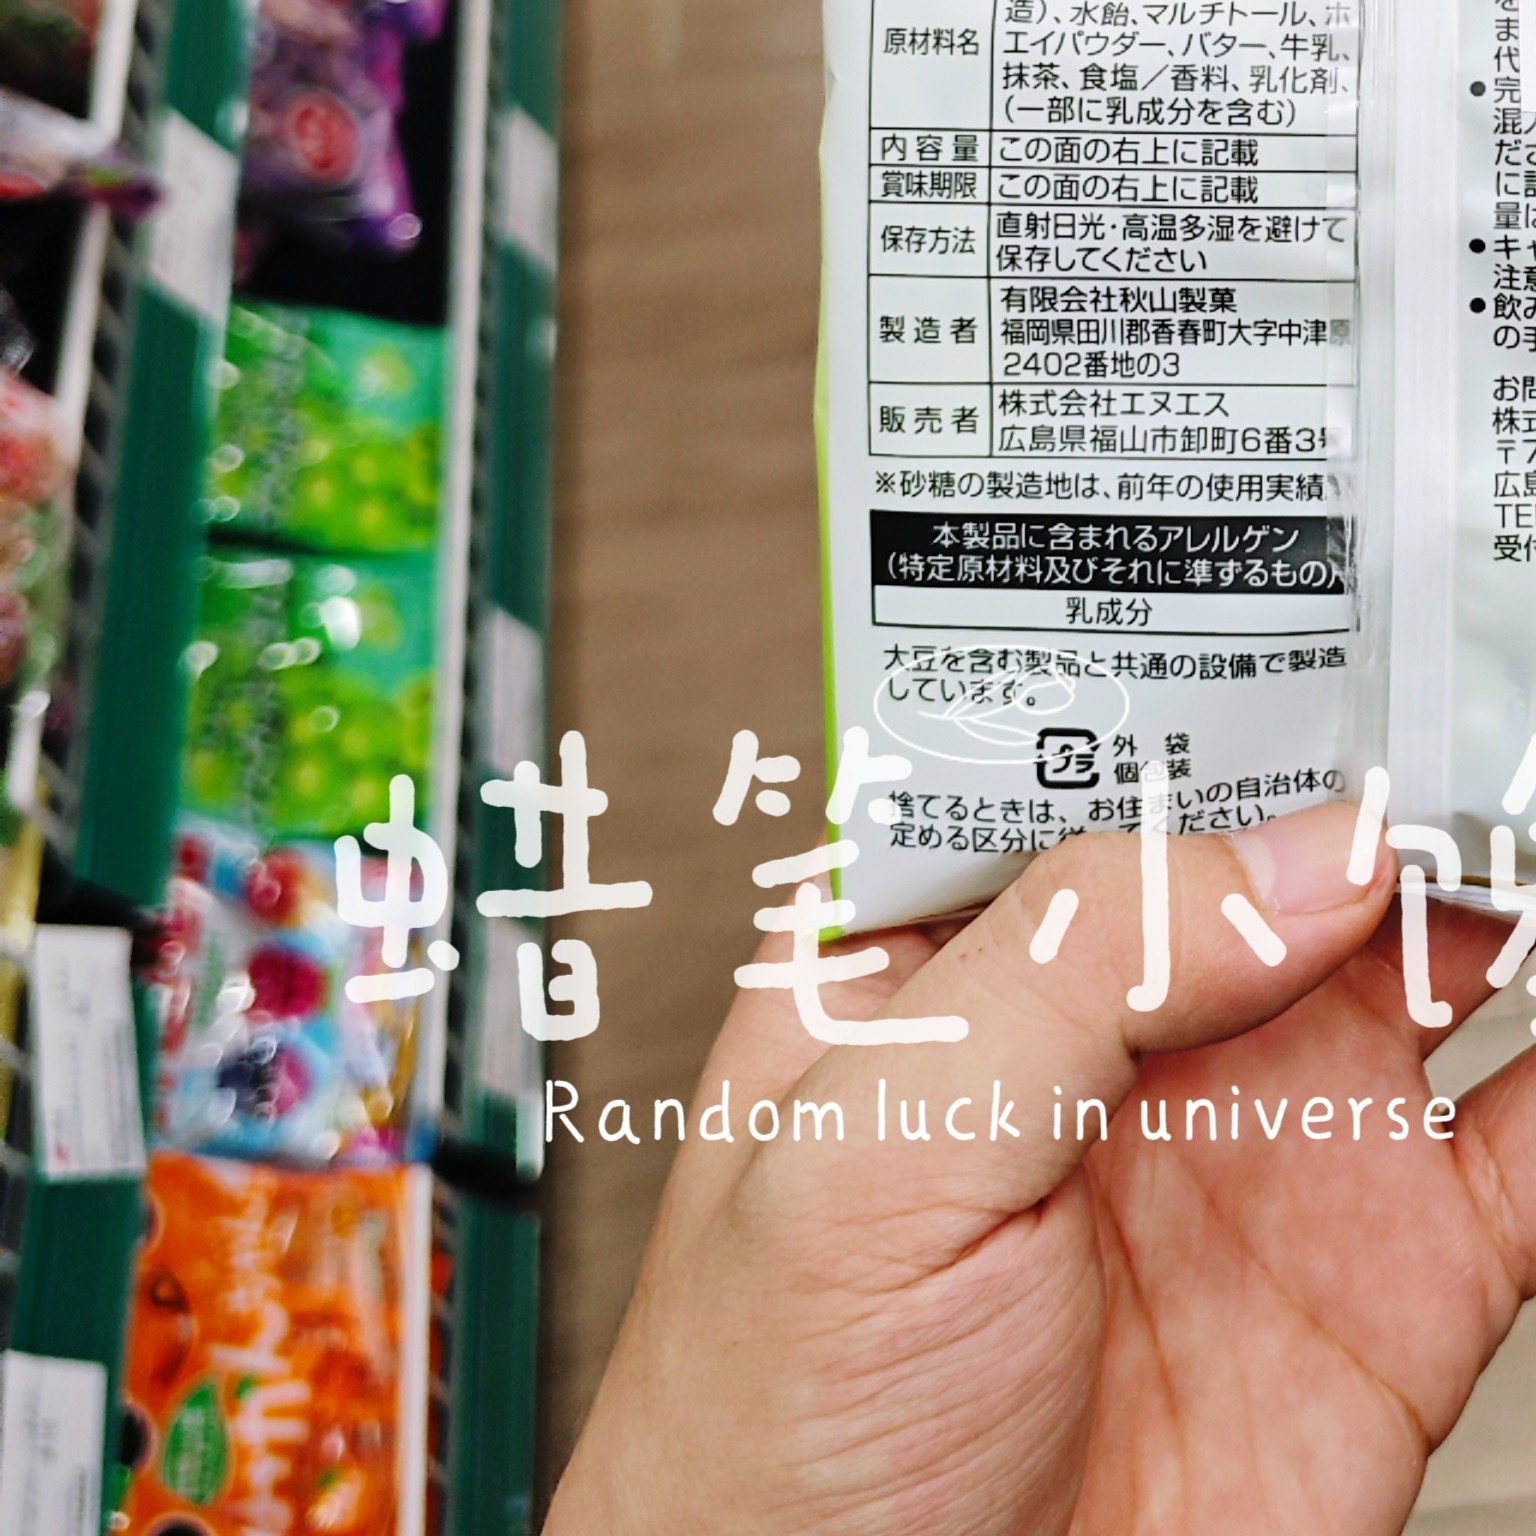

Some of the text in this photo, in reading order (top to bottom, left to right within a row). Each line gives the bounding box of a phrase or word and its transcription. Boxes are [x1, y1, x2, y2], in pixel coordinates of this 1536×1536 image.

[884, 28, 980, 56] 原材料名
[1002, 30, 1352, 62] エイパウダー、バター、牛乳、
[1005, 96, 1297, 127] （一部に乳成分を含む）
[881, 135, 1258, 167] 内容量 この面の右上に記載
[881, 172, 1258, 204] 賞味期限 この面の右上に記載
[881, 226, 976, 255] 保存方法
[996, 213, 1347, 244] 直射日光・高温多湿を避けて
[996, 246, 1207, 274] 保存してください
[1000, 287, 1238, 314] 有限会社秋山製菓
[879, 316, 978, 345] 製造者
[1003, 351, 1181, 378] 2402番地の3
[998, 390, 1230, 418] 株式会社エヌエス
[879, 406, 979, 433] 販売者
[932, 523, 1299, 554] 本製品に含まれるアレルゲン
[1066, 596, 1153, 626] 乳成分
[883, 643, 1347, 681] 大豆を含む製品と共通の設備で製造
[887, 674, 1038, 707] しています。
